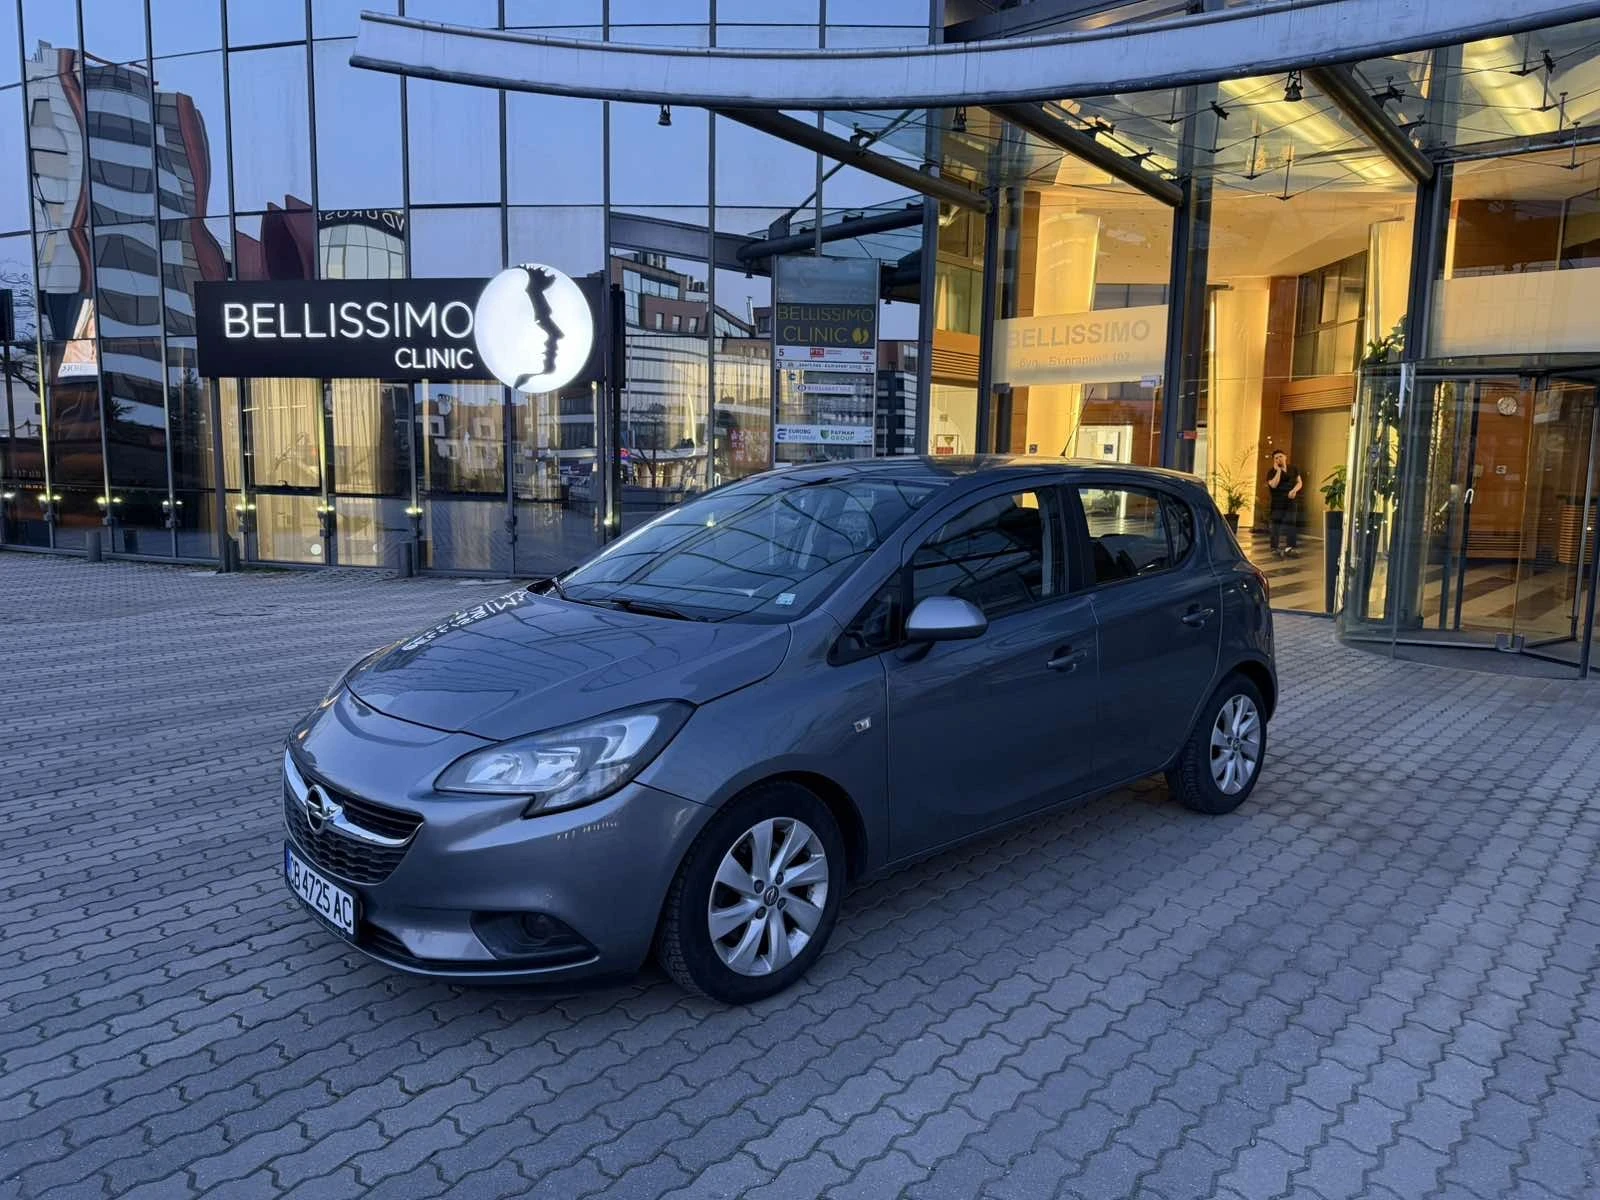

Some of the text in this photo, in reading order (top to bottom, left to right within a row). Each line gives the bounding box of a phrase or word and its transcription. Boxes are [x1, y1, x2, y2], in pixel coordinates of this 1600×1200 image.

[223, 301, 474, 339] BELLISSIMO
[777, 304, 874, 322] BELLISSIMO
[783, 325, 848, 343] CLINIC
[1008, 319, 1150, 348] BELLISSIMO
[394, 347, 475, 370] CLINIC
[778, 348, 785, 357] 5
